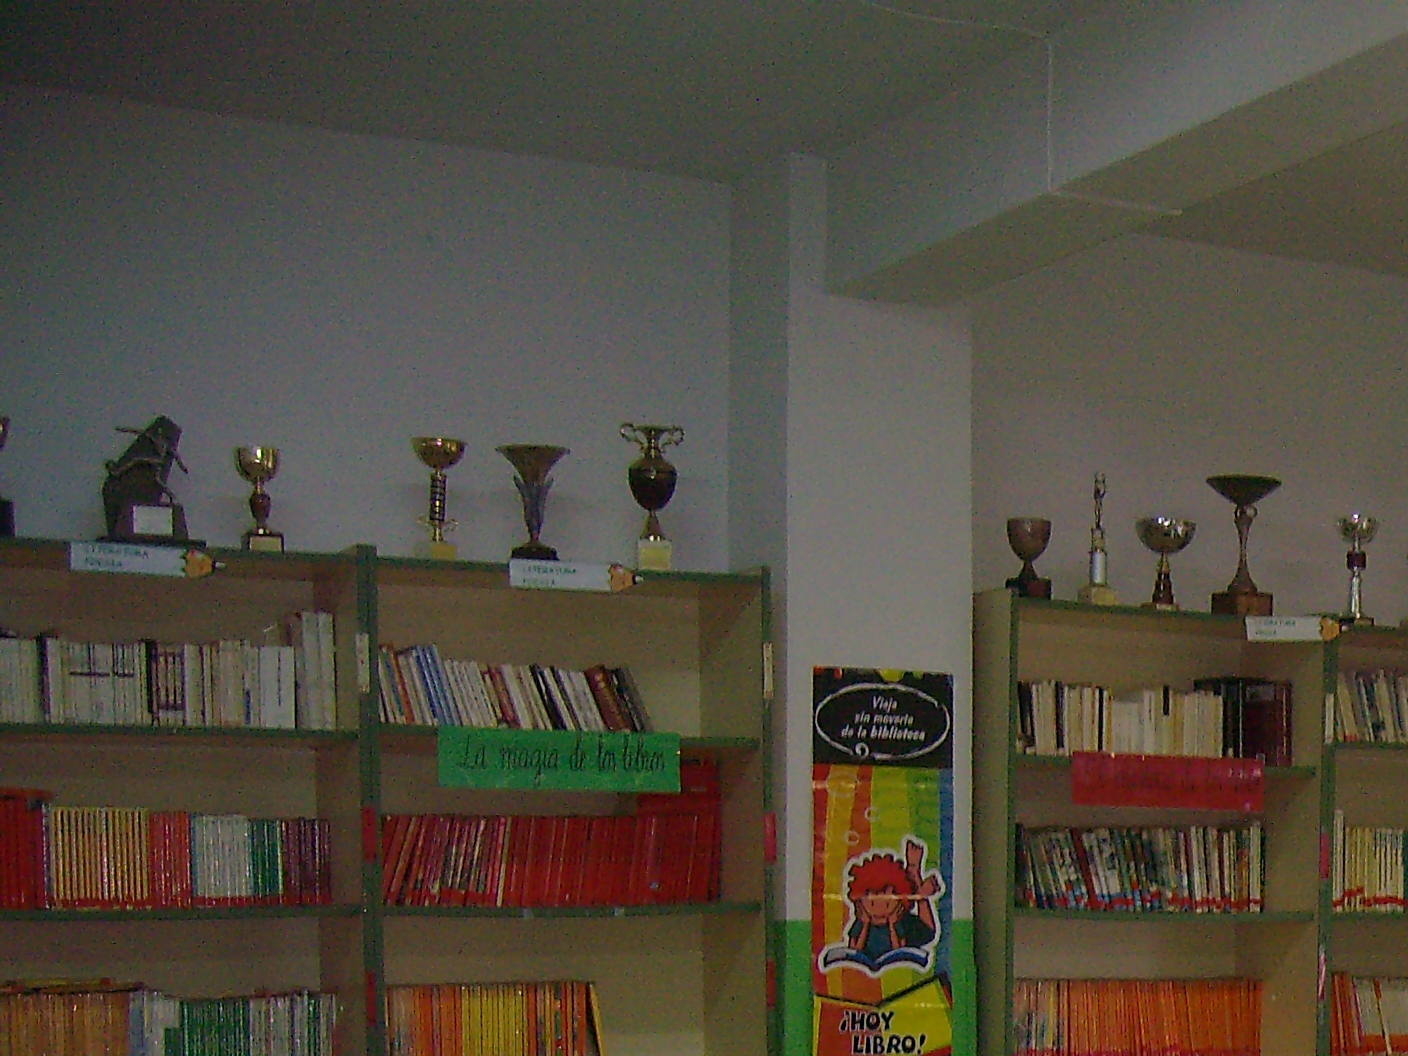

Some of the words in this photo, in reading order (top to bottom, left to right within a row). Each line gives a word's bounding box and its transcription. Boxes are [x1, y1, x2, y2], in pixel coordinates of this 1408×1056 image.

[854, 711, 871, 724] sin
[841, 724, 854, 738] de
[857, 725, 868, 738] la
[870, 725, 926, 741] biblioteca
[457, 735, 487, 769] La
[569, 733, 586, 771] de
[839, 1009, 895, 1032] ¡HOY
[852, 1033, 927, 1056] LIBRO!
